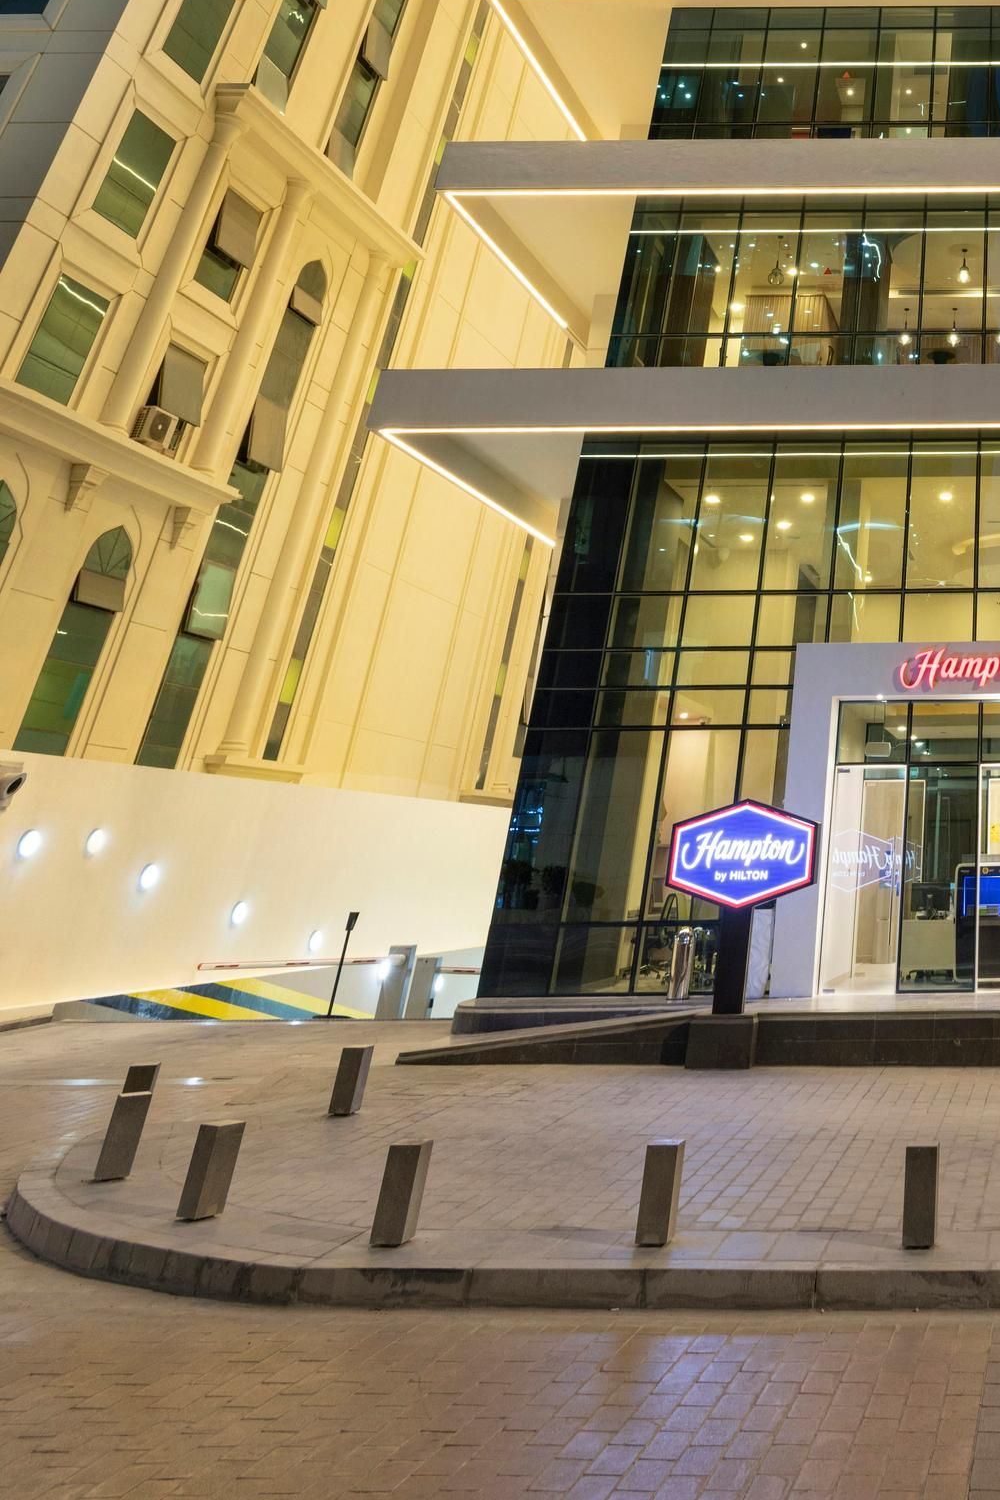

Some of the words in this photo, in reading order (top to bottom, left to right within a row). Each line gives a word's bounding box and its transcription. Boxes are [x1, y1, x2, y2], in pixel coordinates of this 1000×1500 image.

[680, 830, 805, 870] Hampton
[714, 870, 727, 883] by
[729, 870, 769, 881] HILTON
